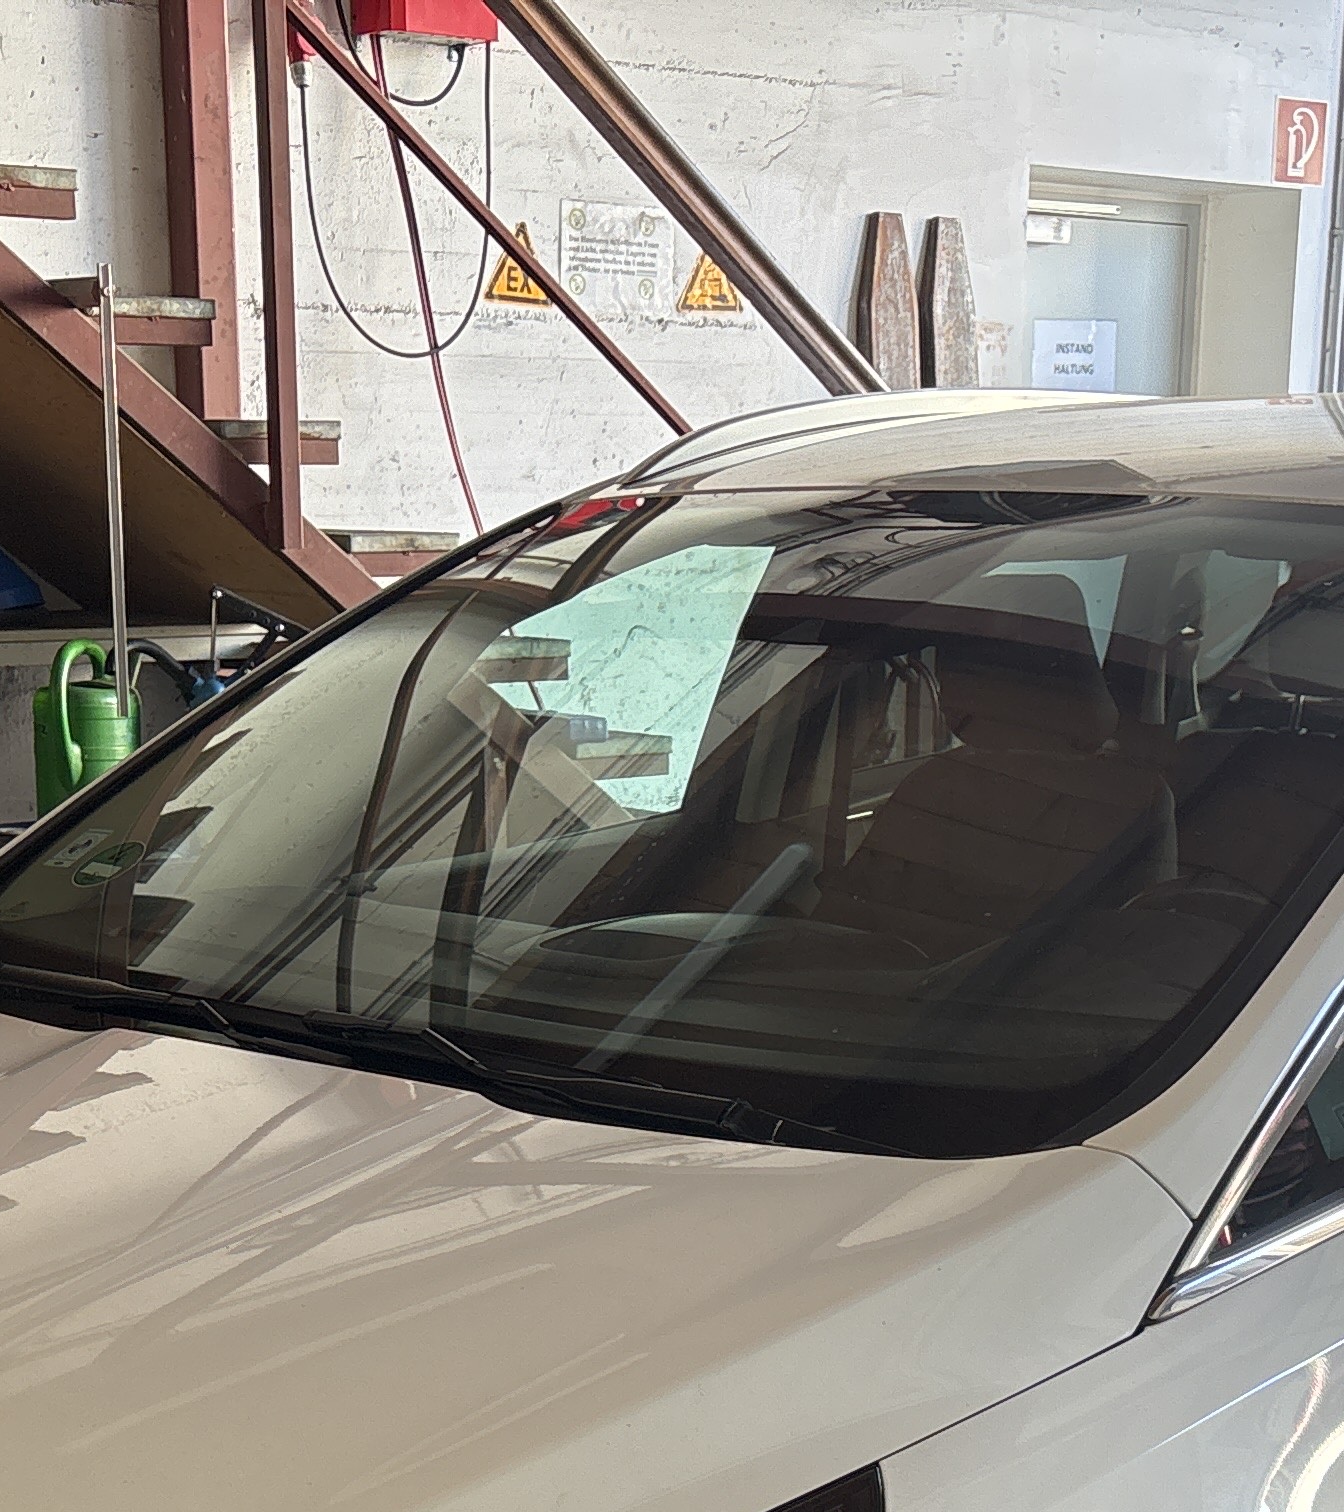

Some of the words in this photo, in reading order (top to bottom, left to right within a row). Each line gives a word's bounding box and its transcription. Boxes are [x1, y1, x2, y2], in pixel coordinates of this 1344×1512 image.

[506, 265, 533, 295] EX
[1055, 343, 1094, 354] INSTAND
[1053, 363, 1094, 375] HALTUNG
